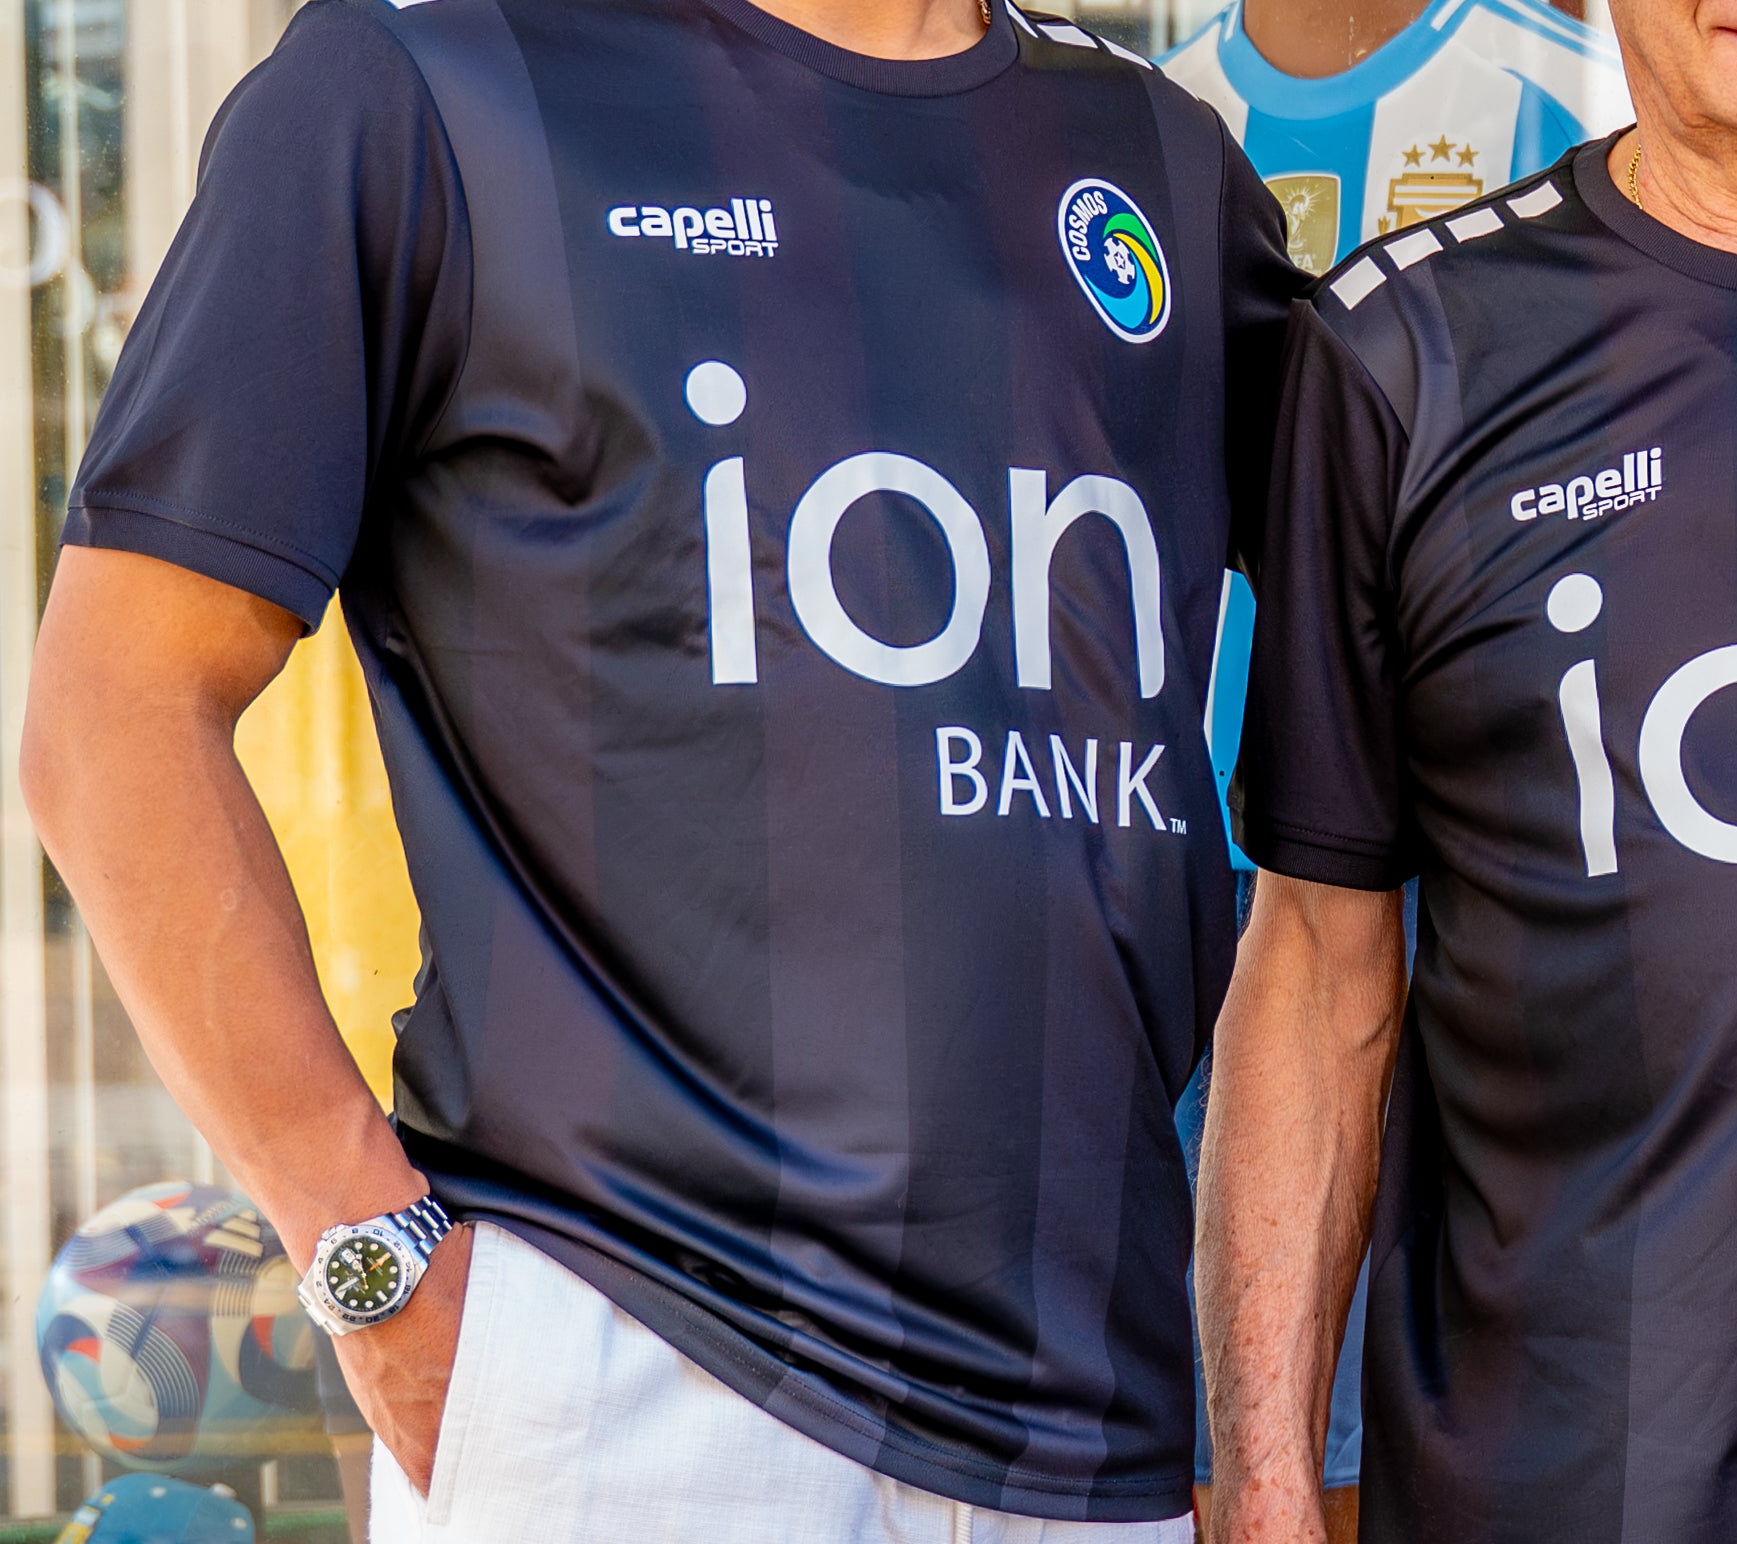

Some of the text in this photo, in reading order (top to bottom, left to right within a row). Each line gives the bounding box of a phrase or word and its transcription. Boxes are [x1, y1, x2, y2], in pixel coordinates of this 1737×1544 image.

[608, 198, 778, 249] capelli
[691, 238, 779, 257] SPORT
[1068, 190, 1108, 262] COSMOS
[1510, 447, 1663, 522] capelli
[1582, 485, 1663, 521] SPORT
[685, 360, 1166, 699] ion
[935, 726, 1168, 832] BANK
